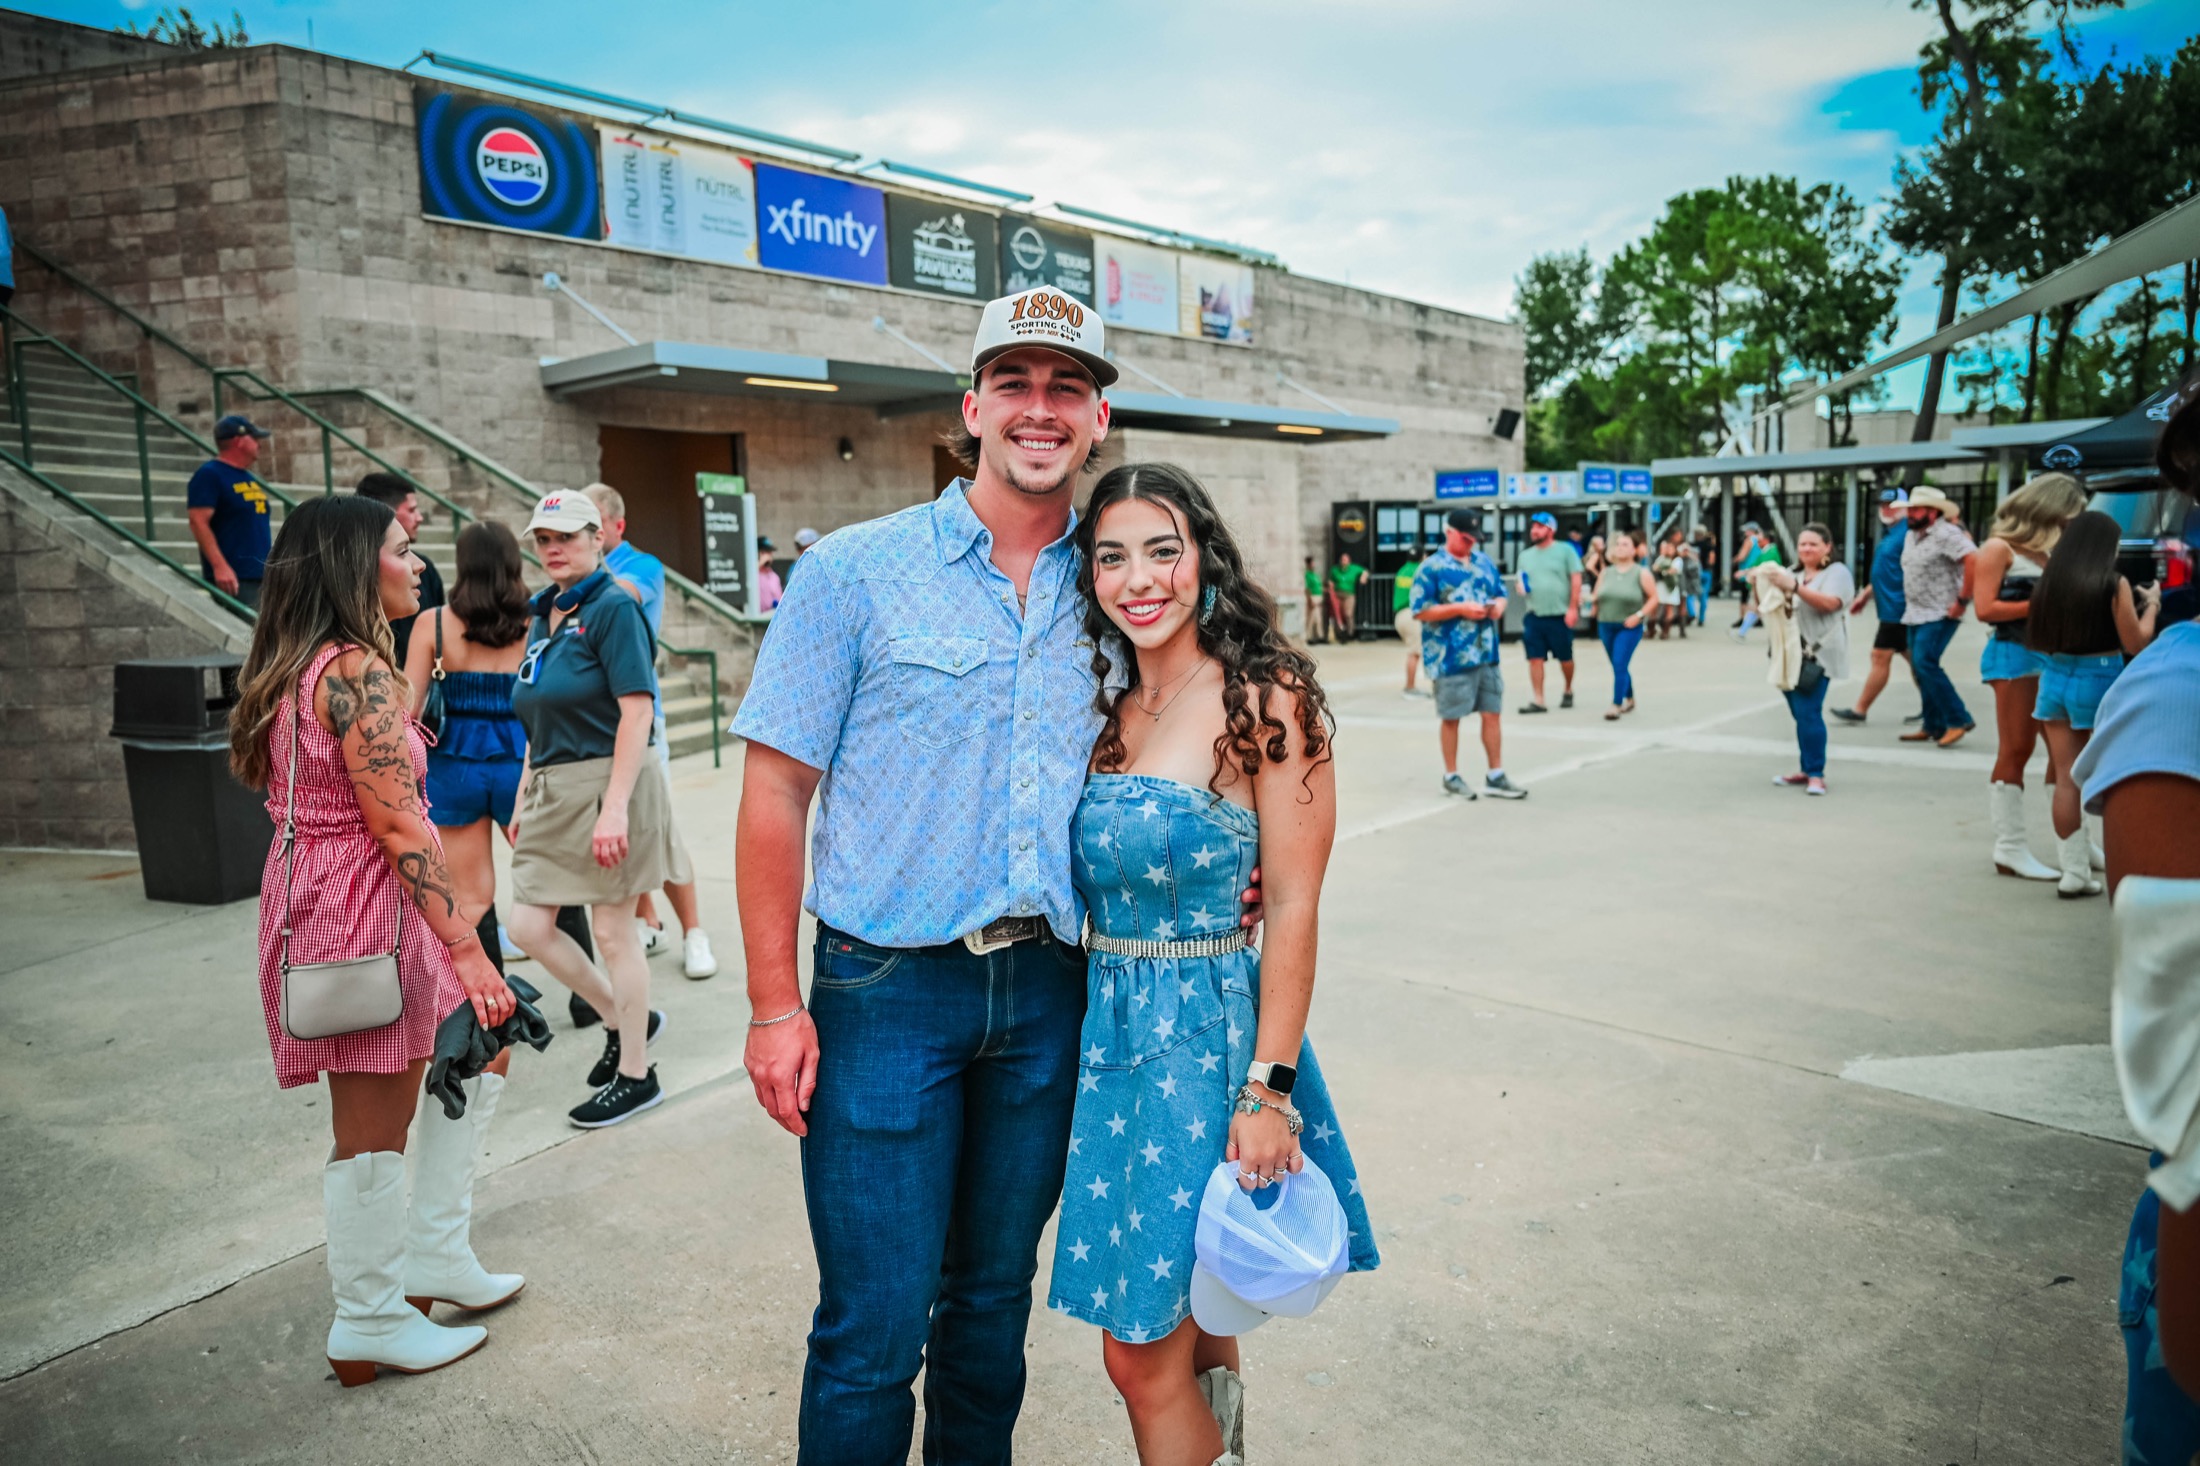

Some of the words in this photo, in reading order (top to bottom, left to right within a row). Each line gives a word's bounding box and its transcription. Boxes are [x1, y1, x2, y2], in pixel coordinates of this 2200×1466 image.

[483, 154, 542, 178] PEPSI
[767, 198, 878, 258] xfinity
[913, 254, 976, 282] PAVILION
[1054, 251, 1092, 273] TEXAS
[1008, 293, 1083, 328] 1890
[1010, 321, 1057, 331] SPORTING
[1060, 324, 1082, 339] CLUB
